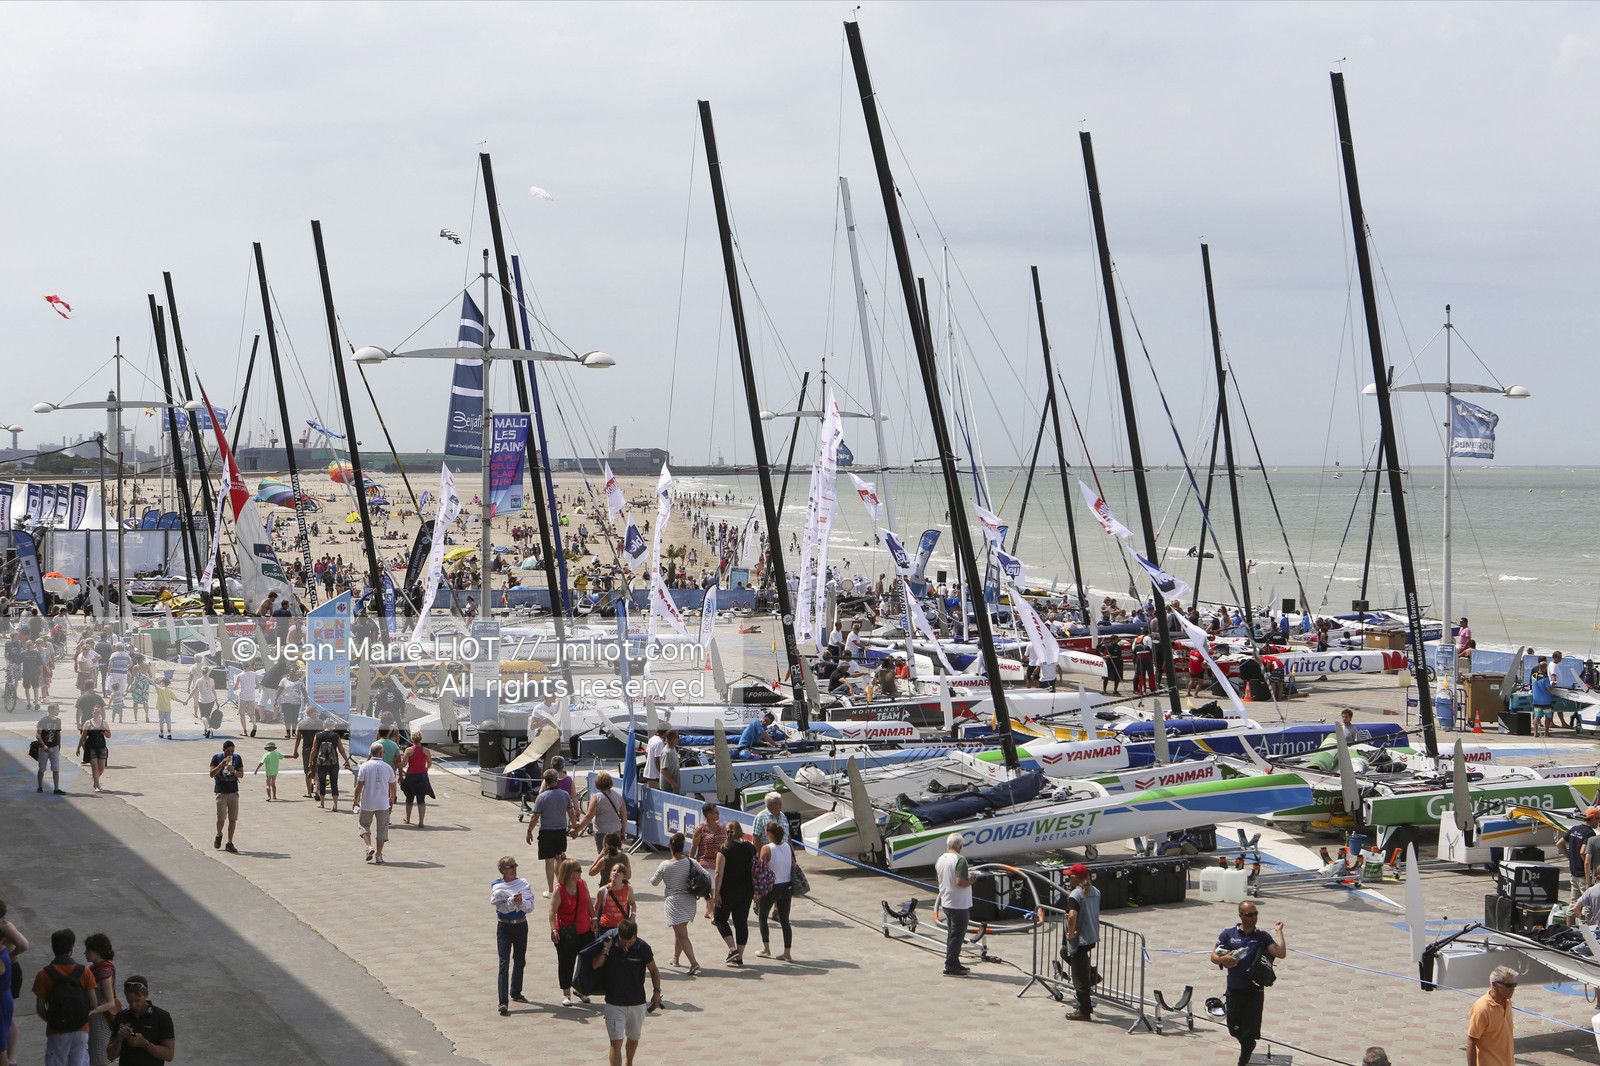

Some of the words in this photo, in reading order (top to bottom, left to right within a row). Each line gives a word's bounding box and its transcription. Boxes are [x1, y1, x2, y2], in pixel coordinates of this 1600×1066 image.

[494, 418, 528, 428] MALO
[494, 429, 517, 440] LES
[1079, 657, 1104, 668] YANMAR
[1327, 655, 1362, 673] CoQ
[951, 679, 990, 688] YANMAR
[876, 711, 900, 721] TEAM
[863, 727, 914, 738] YANMAR
[1066, 744, 1122, 762] YANMAR
[1157, 765, 1214, 787] YANMAR
[1426, 792, 1554, 820] Gupama
[1034, 827, 1093, 843] BRETAGNE
